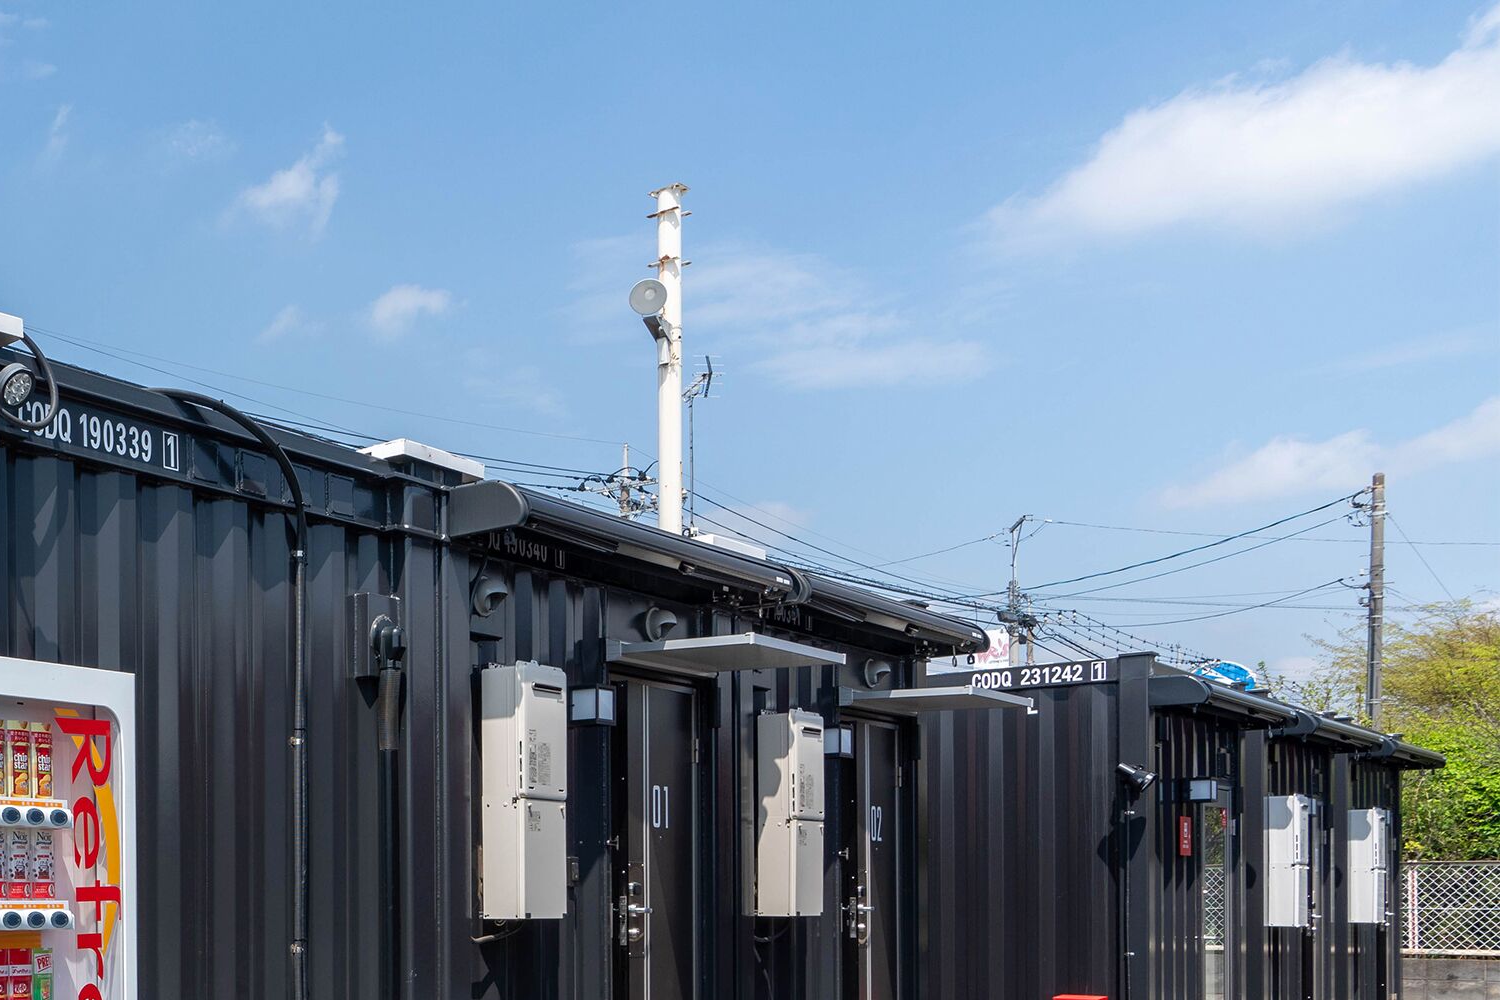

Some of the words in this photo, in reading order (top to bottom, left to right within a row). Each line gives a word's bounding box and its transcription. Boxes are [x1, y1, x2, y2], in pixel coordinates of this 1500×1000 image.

[79, 413, 152, 463] 190339
[166, 435, 175, 468] 1
[972, 670, 1012, 690] CODQ
[1020, 664, 1083, 686] 231242
[653, 785, 669, 829] 01
[871, 805, 882, 842] 02
